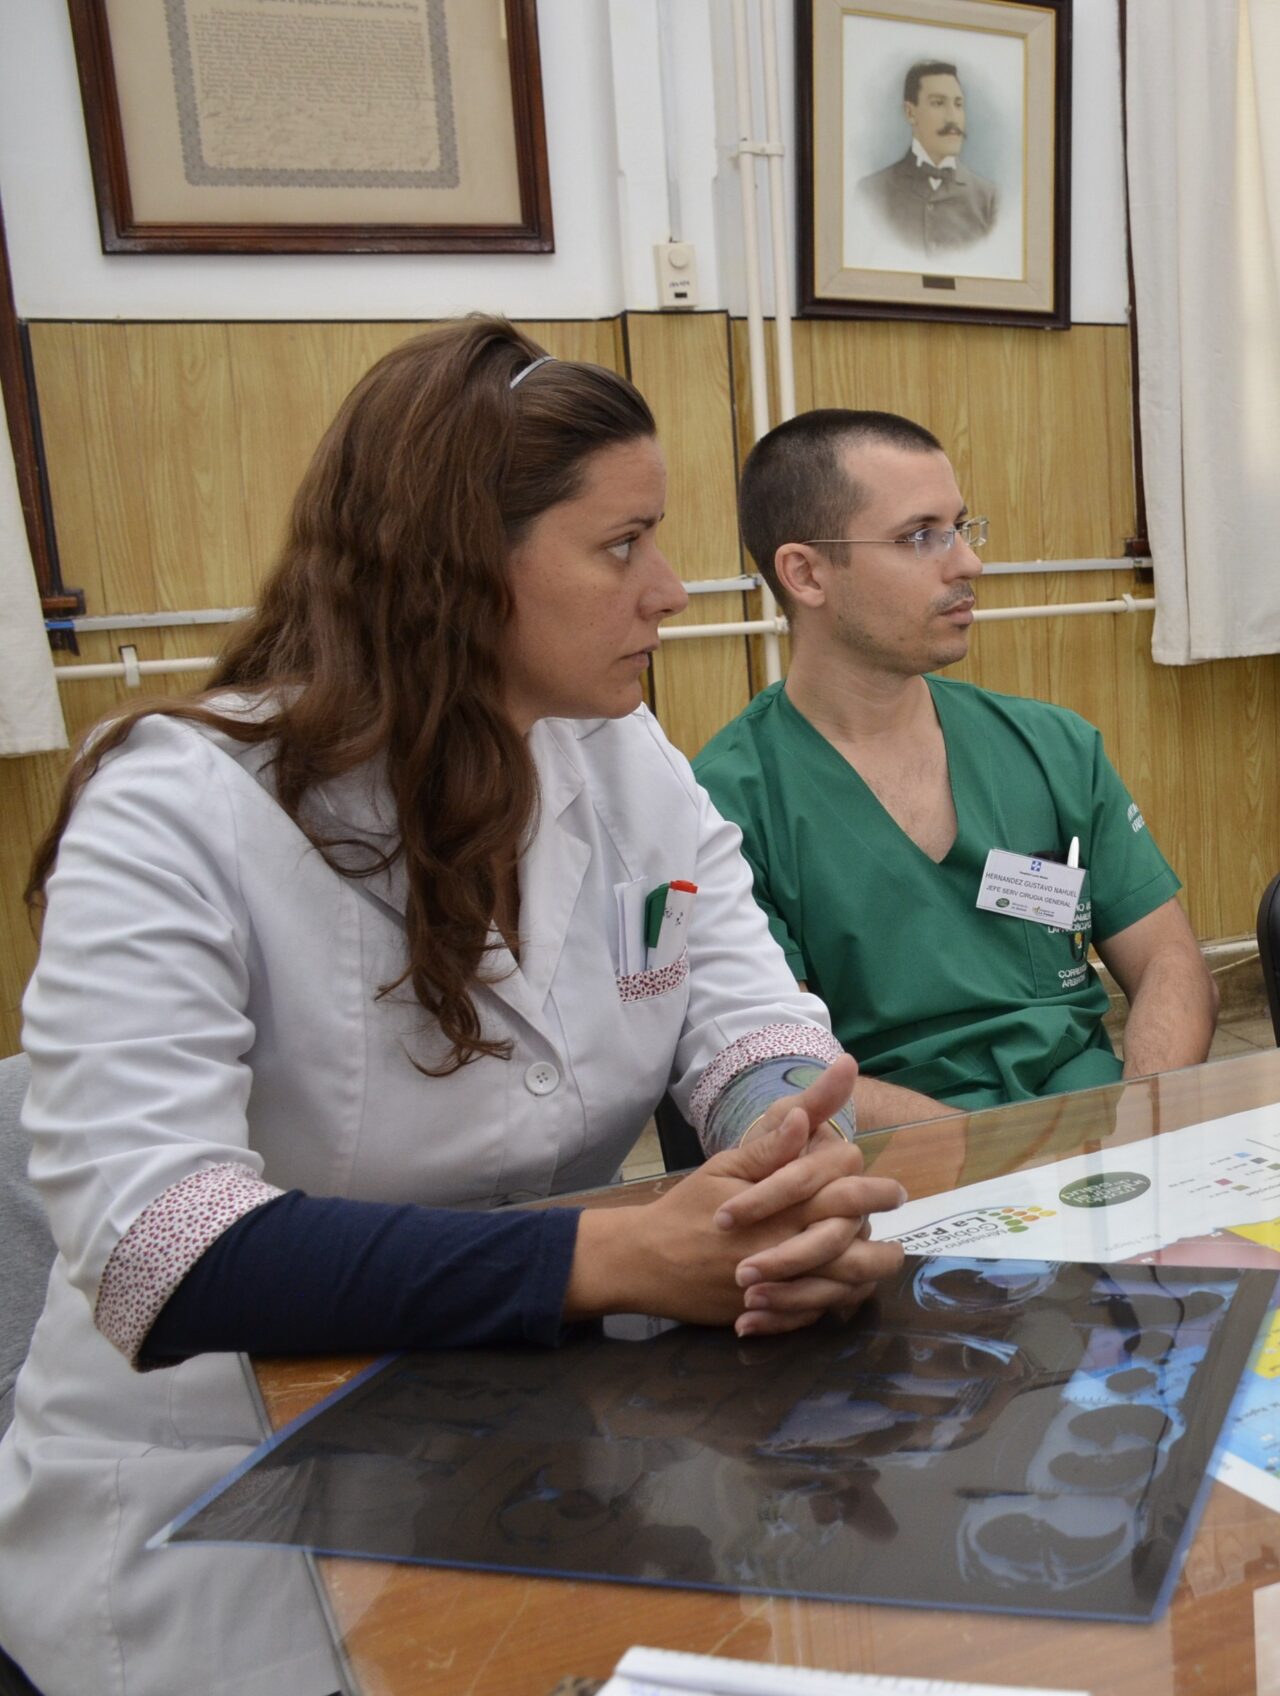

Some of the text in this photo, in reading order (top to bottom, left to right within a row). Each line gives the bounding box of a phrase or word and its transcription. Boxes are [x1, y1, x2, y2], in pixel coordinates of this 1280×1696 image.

[985, 872, 1024, 886] HERNANDEZ
[1023, 880, 1053, 892] GUSTAVO
[1054, 887, 1077, 898] NAHUEL
[1044, 896, 1071, 908] GENERAL
[954, 1217, 986, 1227] La
[905, 1223, 998, 1251] Gobierno
